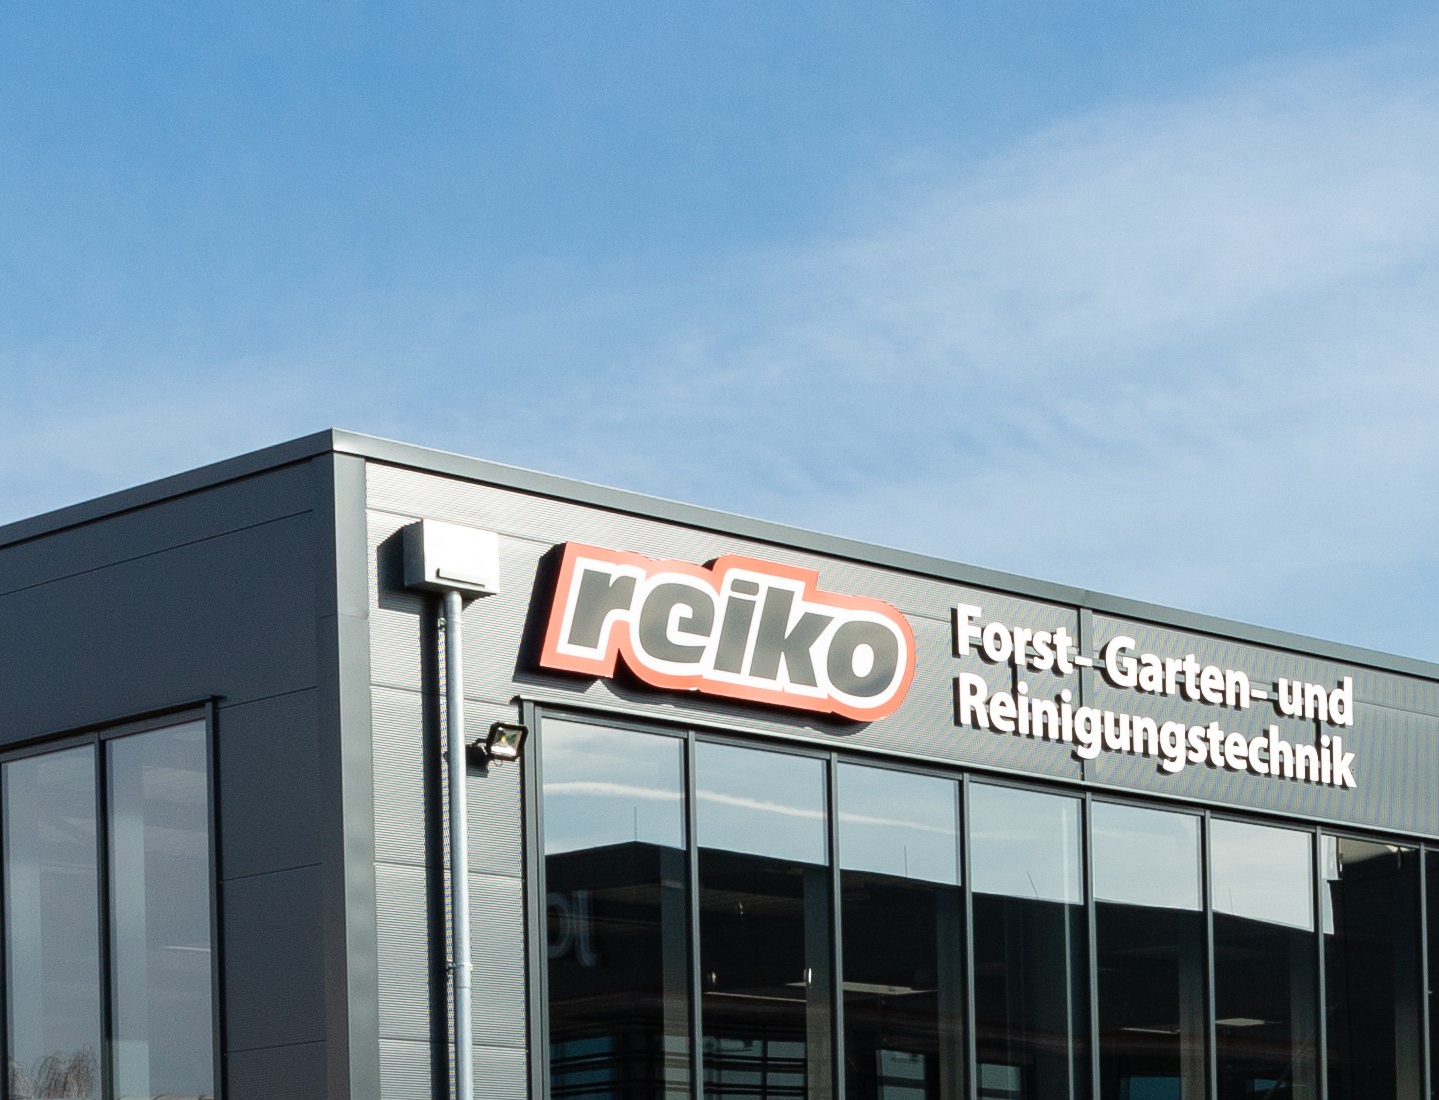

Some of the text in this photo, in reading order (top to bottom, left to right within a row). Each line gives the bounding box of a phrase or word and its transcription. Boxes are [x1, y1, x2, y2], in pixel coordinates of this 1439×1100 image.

[565, 566, 902, 702] reiko
[956, 603, 1354, 727] Forst- Garten- und
[956, 671, 1358, 790] Reinigungstechnik
